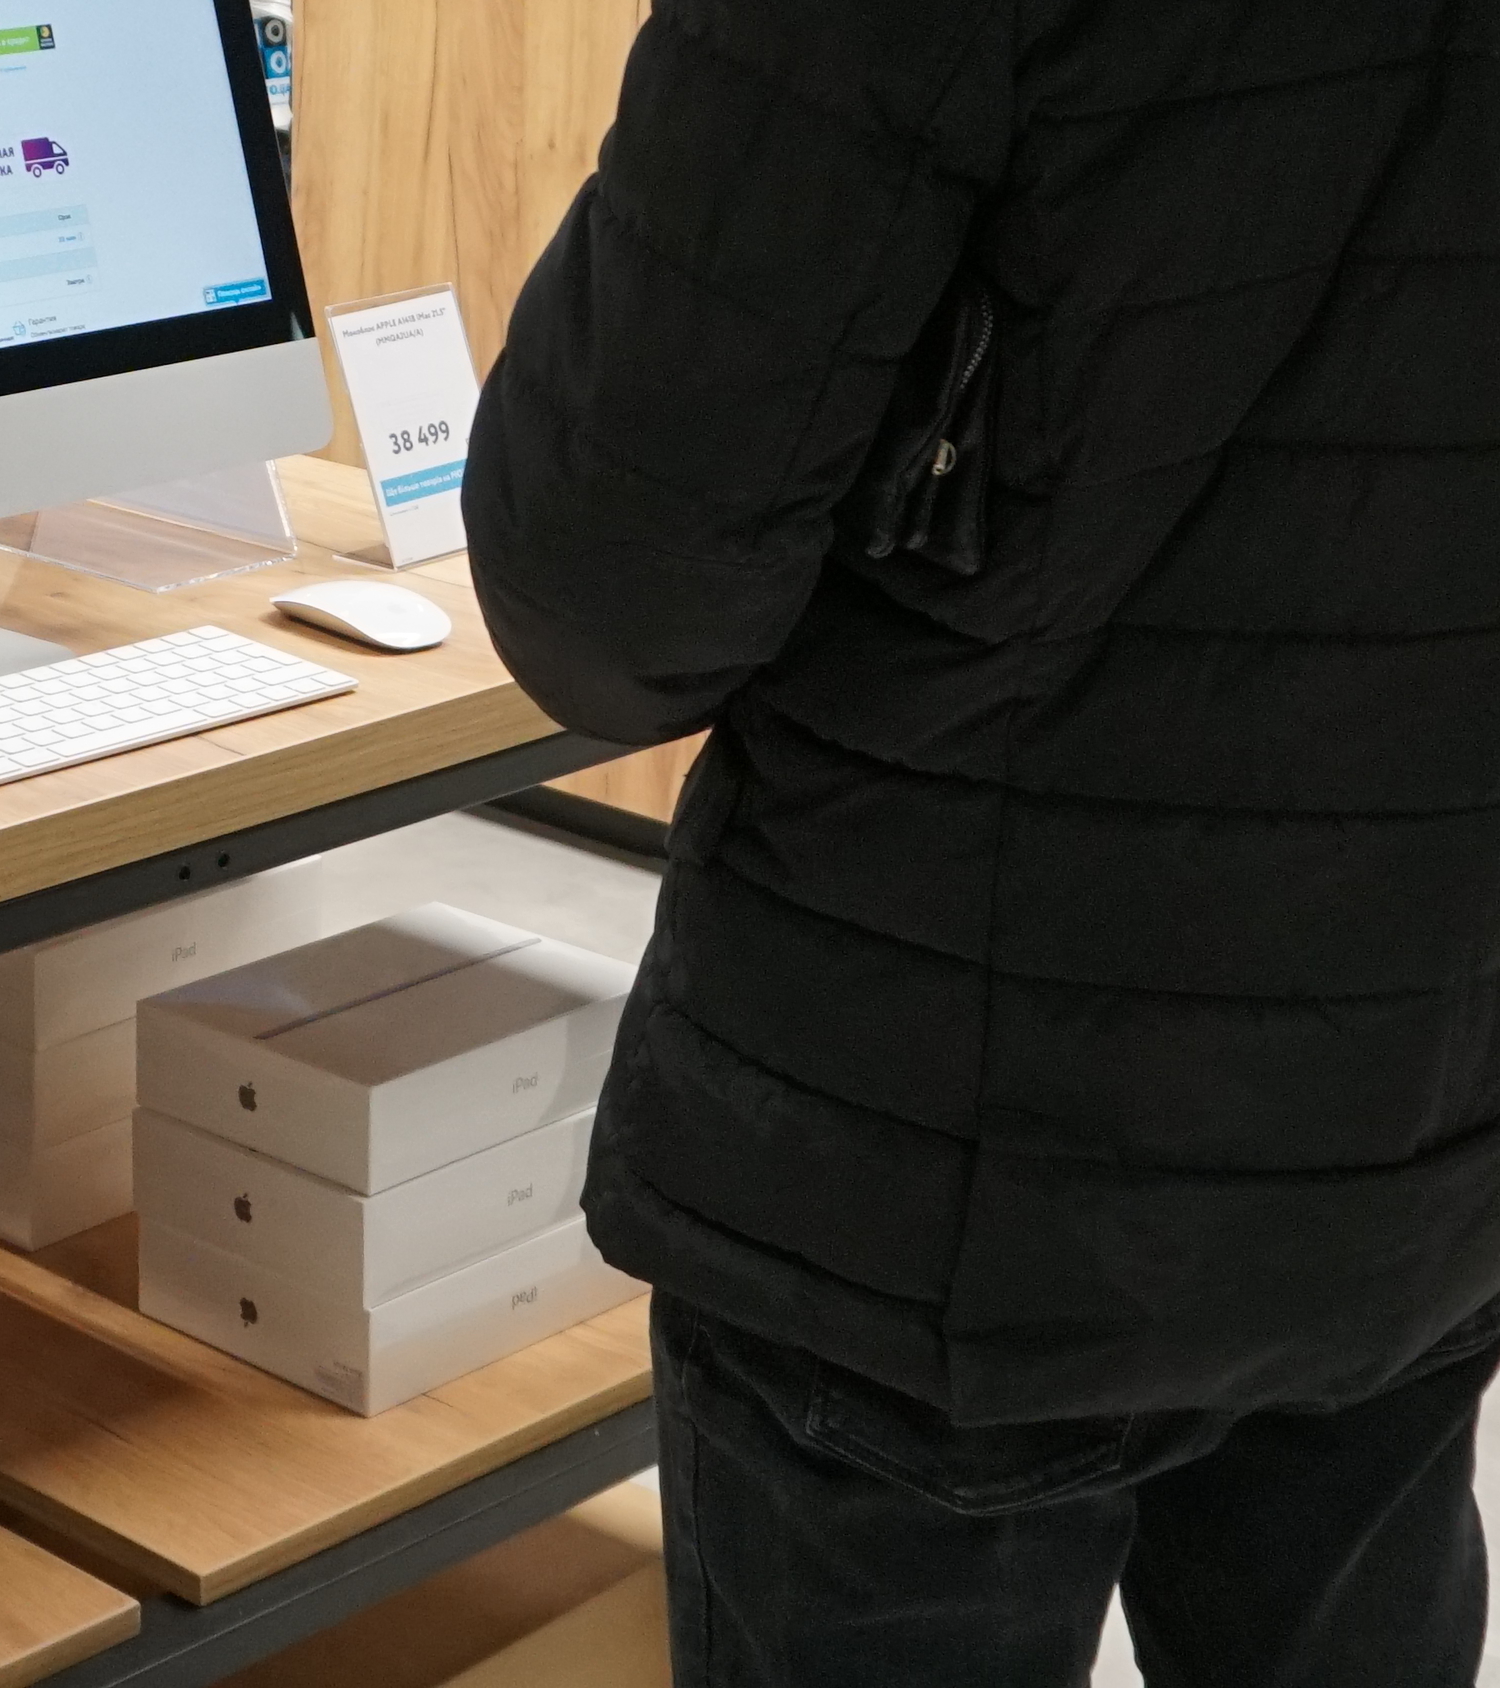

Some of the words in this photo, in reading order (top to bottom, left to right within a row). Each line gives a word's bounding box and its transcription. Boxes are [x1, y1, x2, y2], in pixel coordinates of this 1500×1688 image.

[388, 428, 414, 455] 38
[417, 419, 451, 447] 499
[171, 942, 197, 963] iPad
[511, 1071, 539, 1095] iPad
[507, 1183, 533, 1207] iPad
[510, 1285, 538, 1311] iPad
